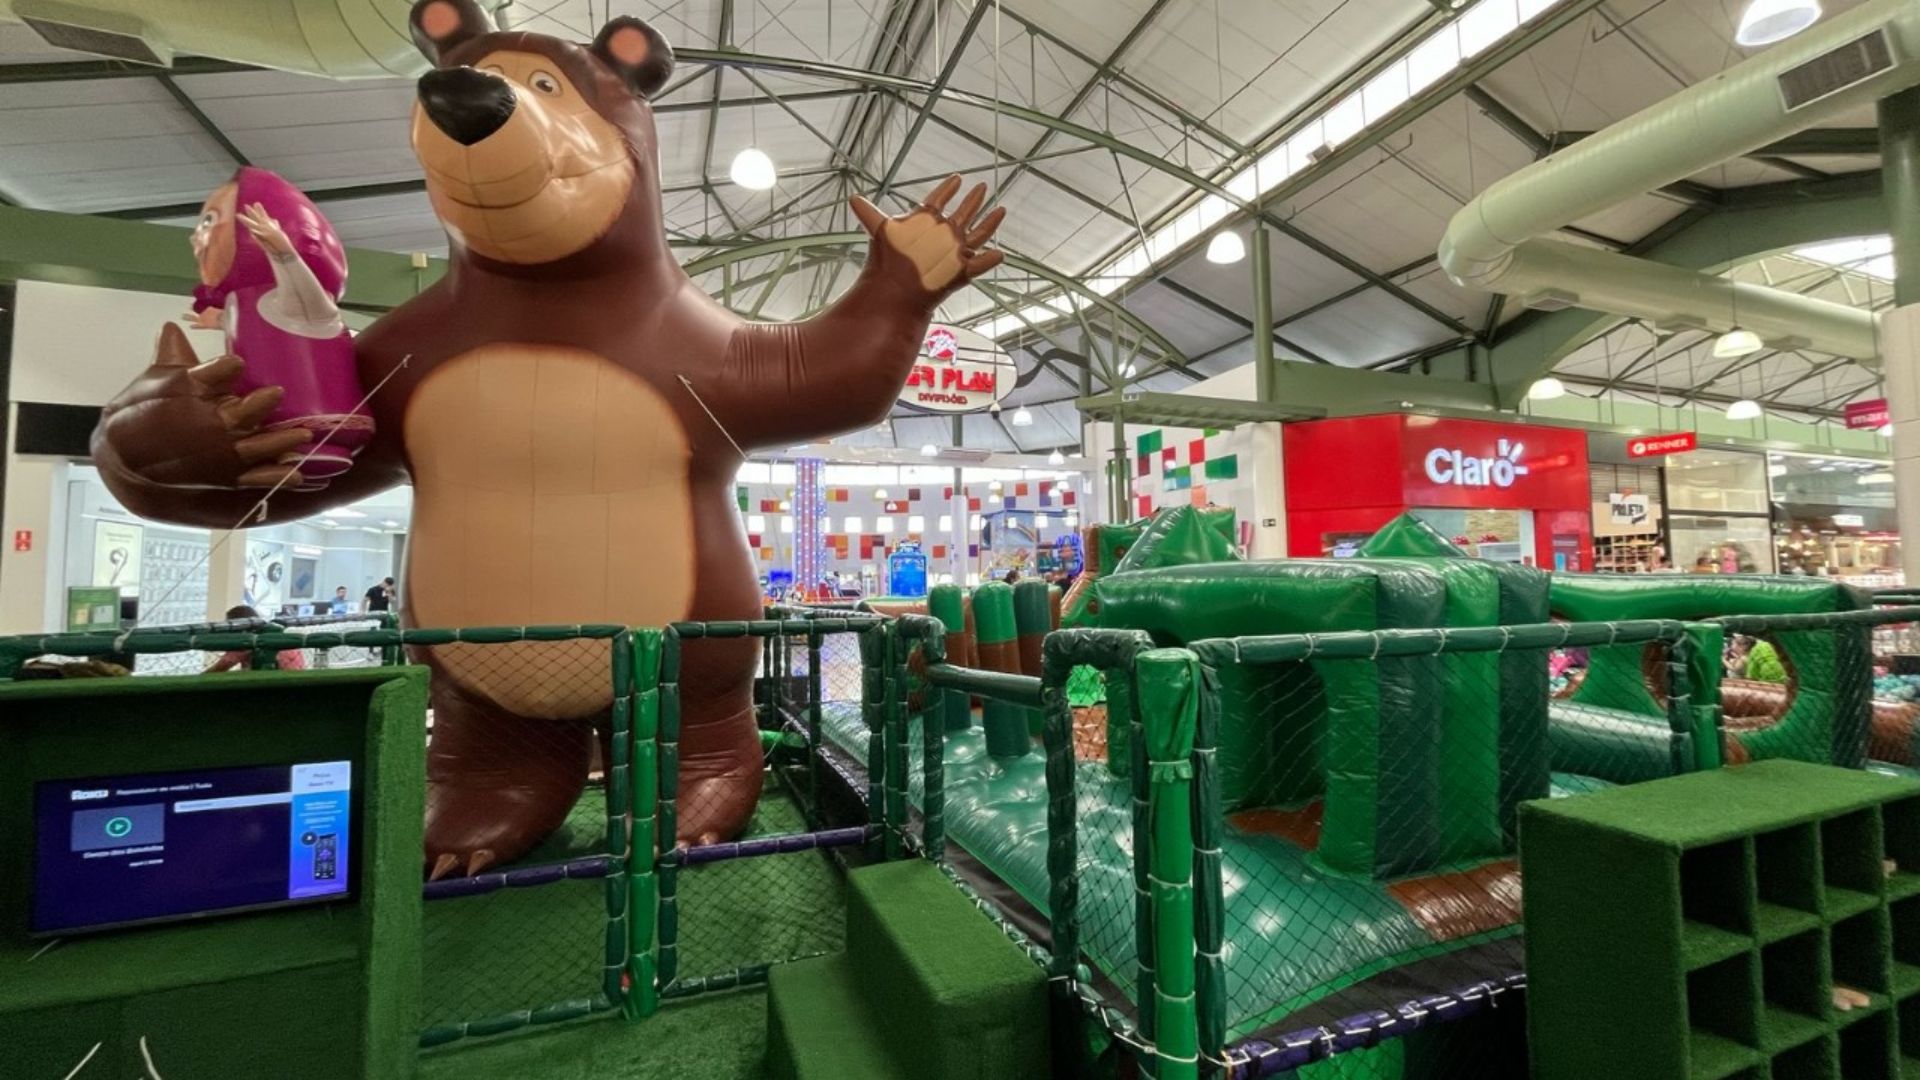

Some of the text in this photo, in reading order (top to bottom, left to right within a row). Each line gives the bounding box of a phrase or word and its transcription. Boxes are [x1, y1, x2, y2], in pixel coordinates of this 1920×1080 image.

[942, 367, 996, 394] PLAY
[1646, 438, 1689, 452] RENNER
[1425, 446, 1517, 488] Claro
